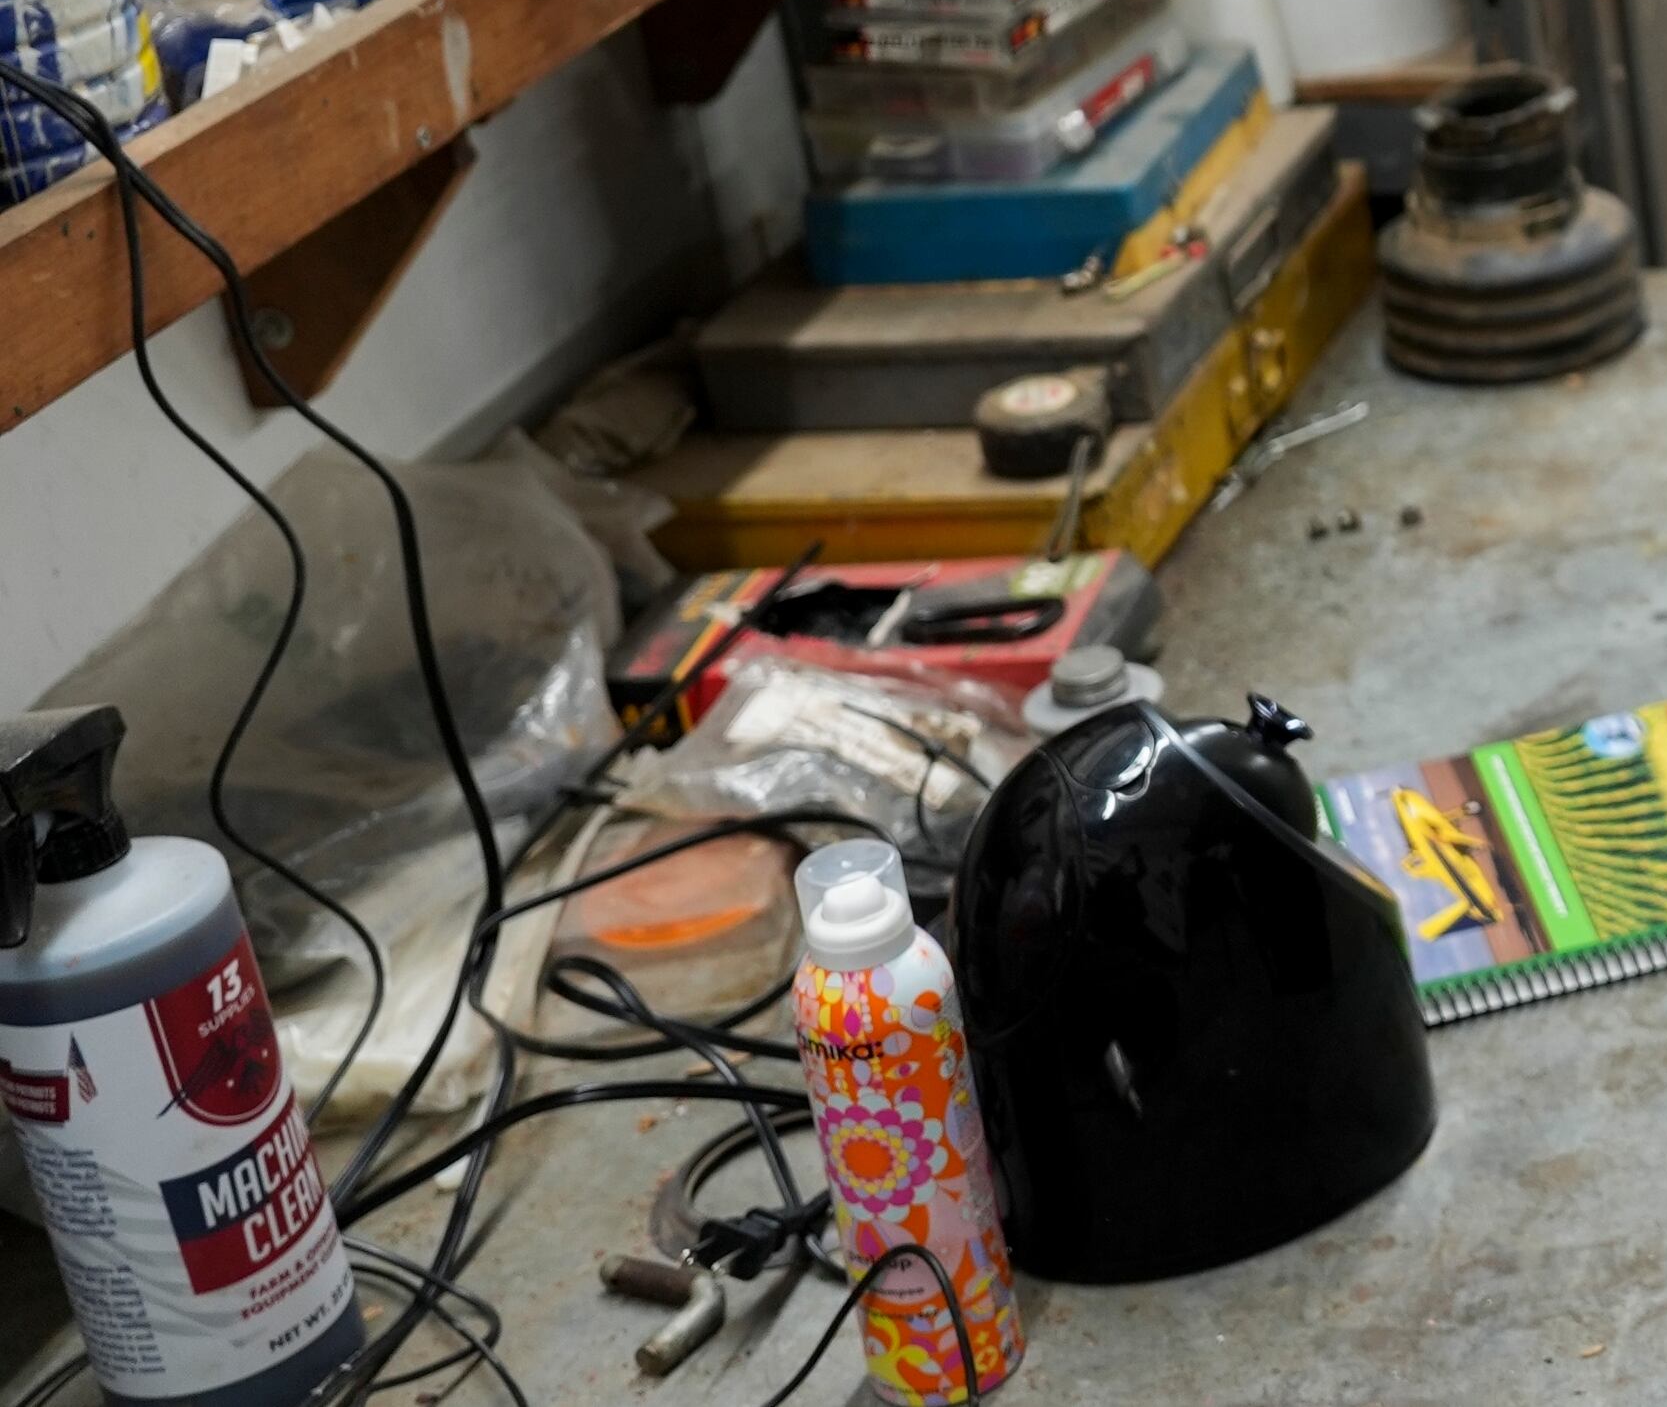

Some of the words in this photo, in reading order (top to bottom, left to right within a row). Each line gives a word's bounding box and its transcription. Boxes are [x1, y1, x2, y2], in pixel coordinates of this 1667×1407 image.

[207, 958, 242, 1012] 13
[249, 1269, 291, 1300] FARM
[268, 1324, 302, 1352] NET
